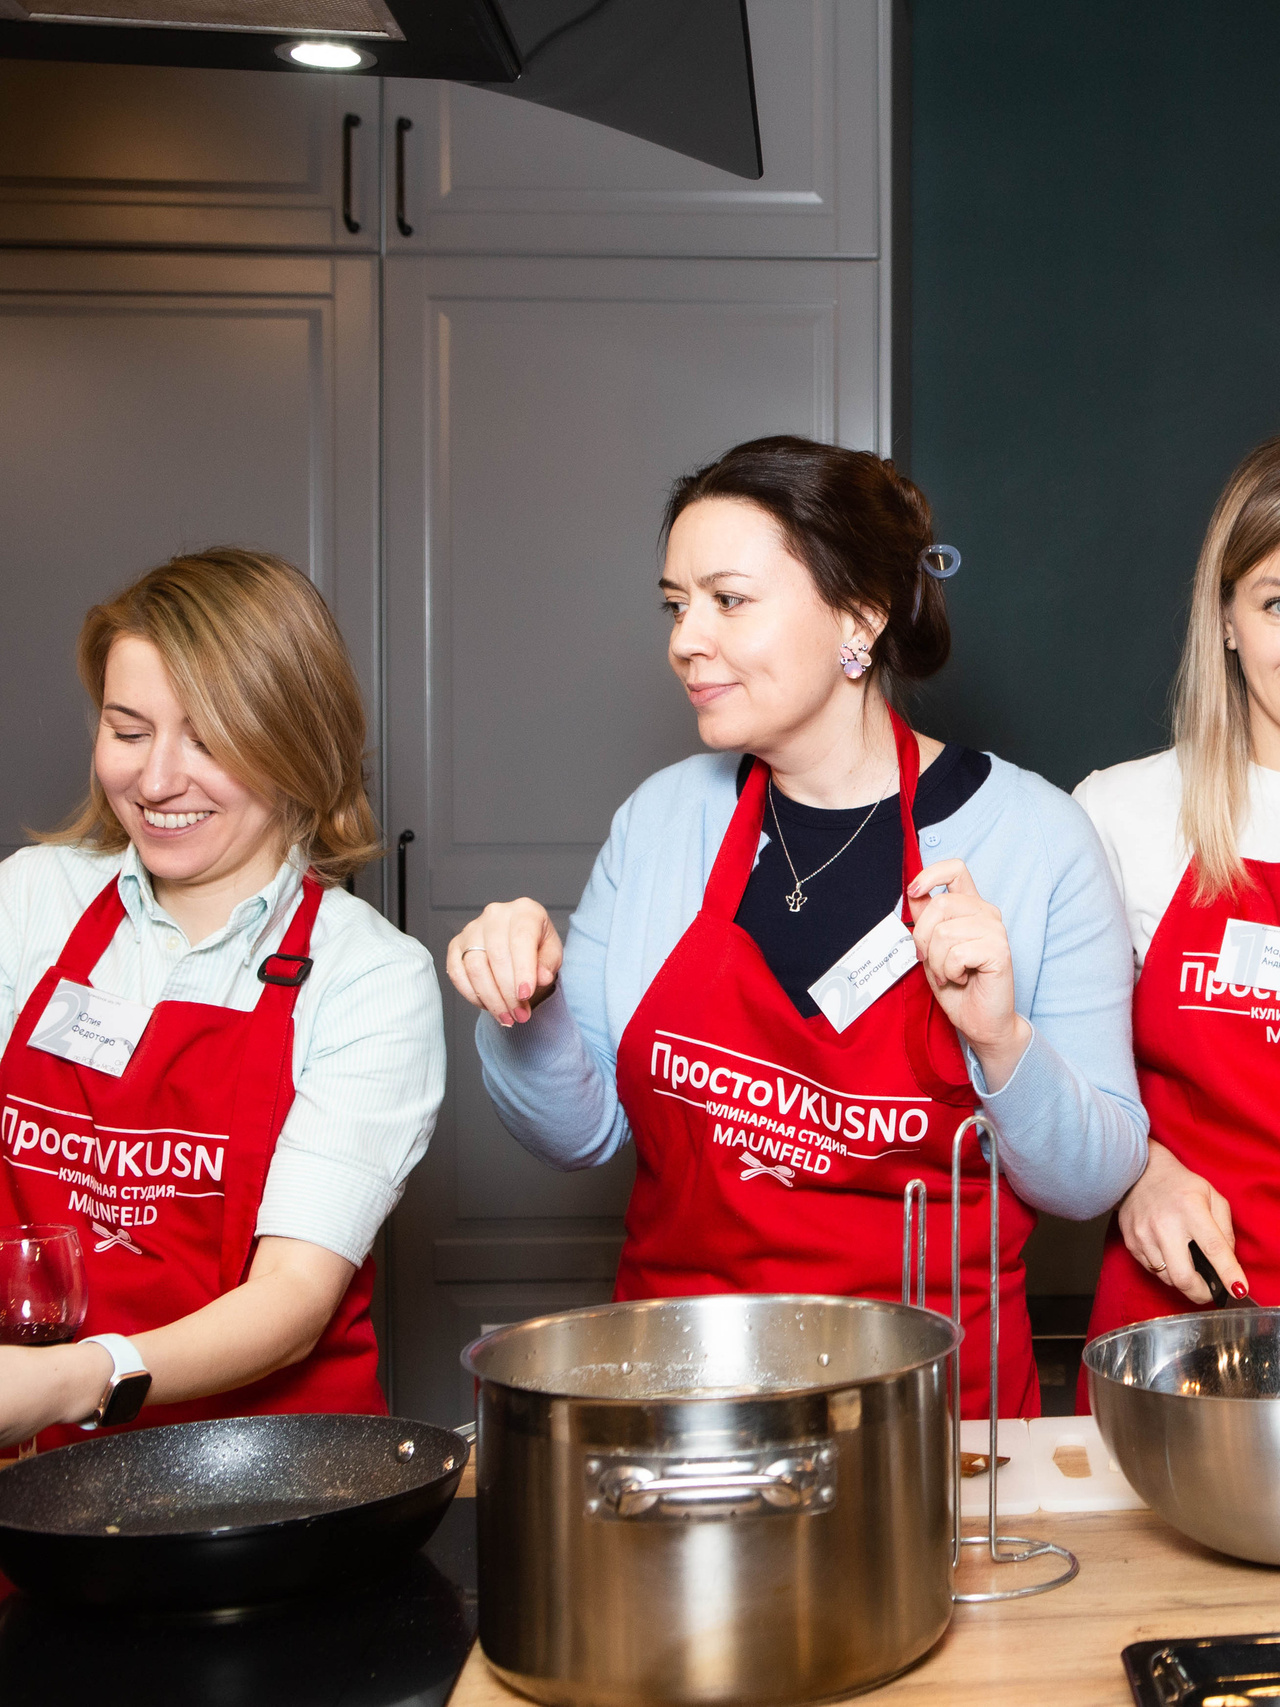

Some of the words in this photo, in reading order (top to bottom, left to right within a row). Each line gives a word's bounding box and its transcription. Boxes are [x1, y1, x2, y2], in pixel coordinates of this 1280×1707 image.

[847, 959, 872, 982] Юлия
[852, 947, 899, 989] Торгашева
[26, 980, 90, 1056] 2
[77, 1010, 102, 1027] Юлия
[807, 966, 874, 1033] 2
[71, 1024, 116, 1046] Федотова
[650, 1041, 929, 1143] ПростоVKUSNO
[705, 1100, 796, 1139] КУЛИНАРНАЯ
[797, 1129, 848, 1157] СТУДИЯ
[712, 1123, 831, 1175] MAUNFELD
[68, 1190, 158, 1227] MAUNFELD
[120, 1184, 176, 1202] СТУДИЯ
